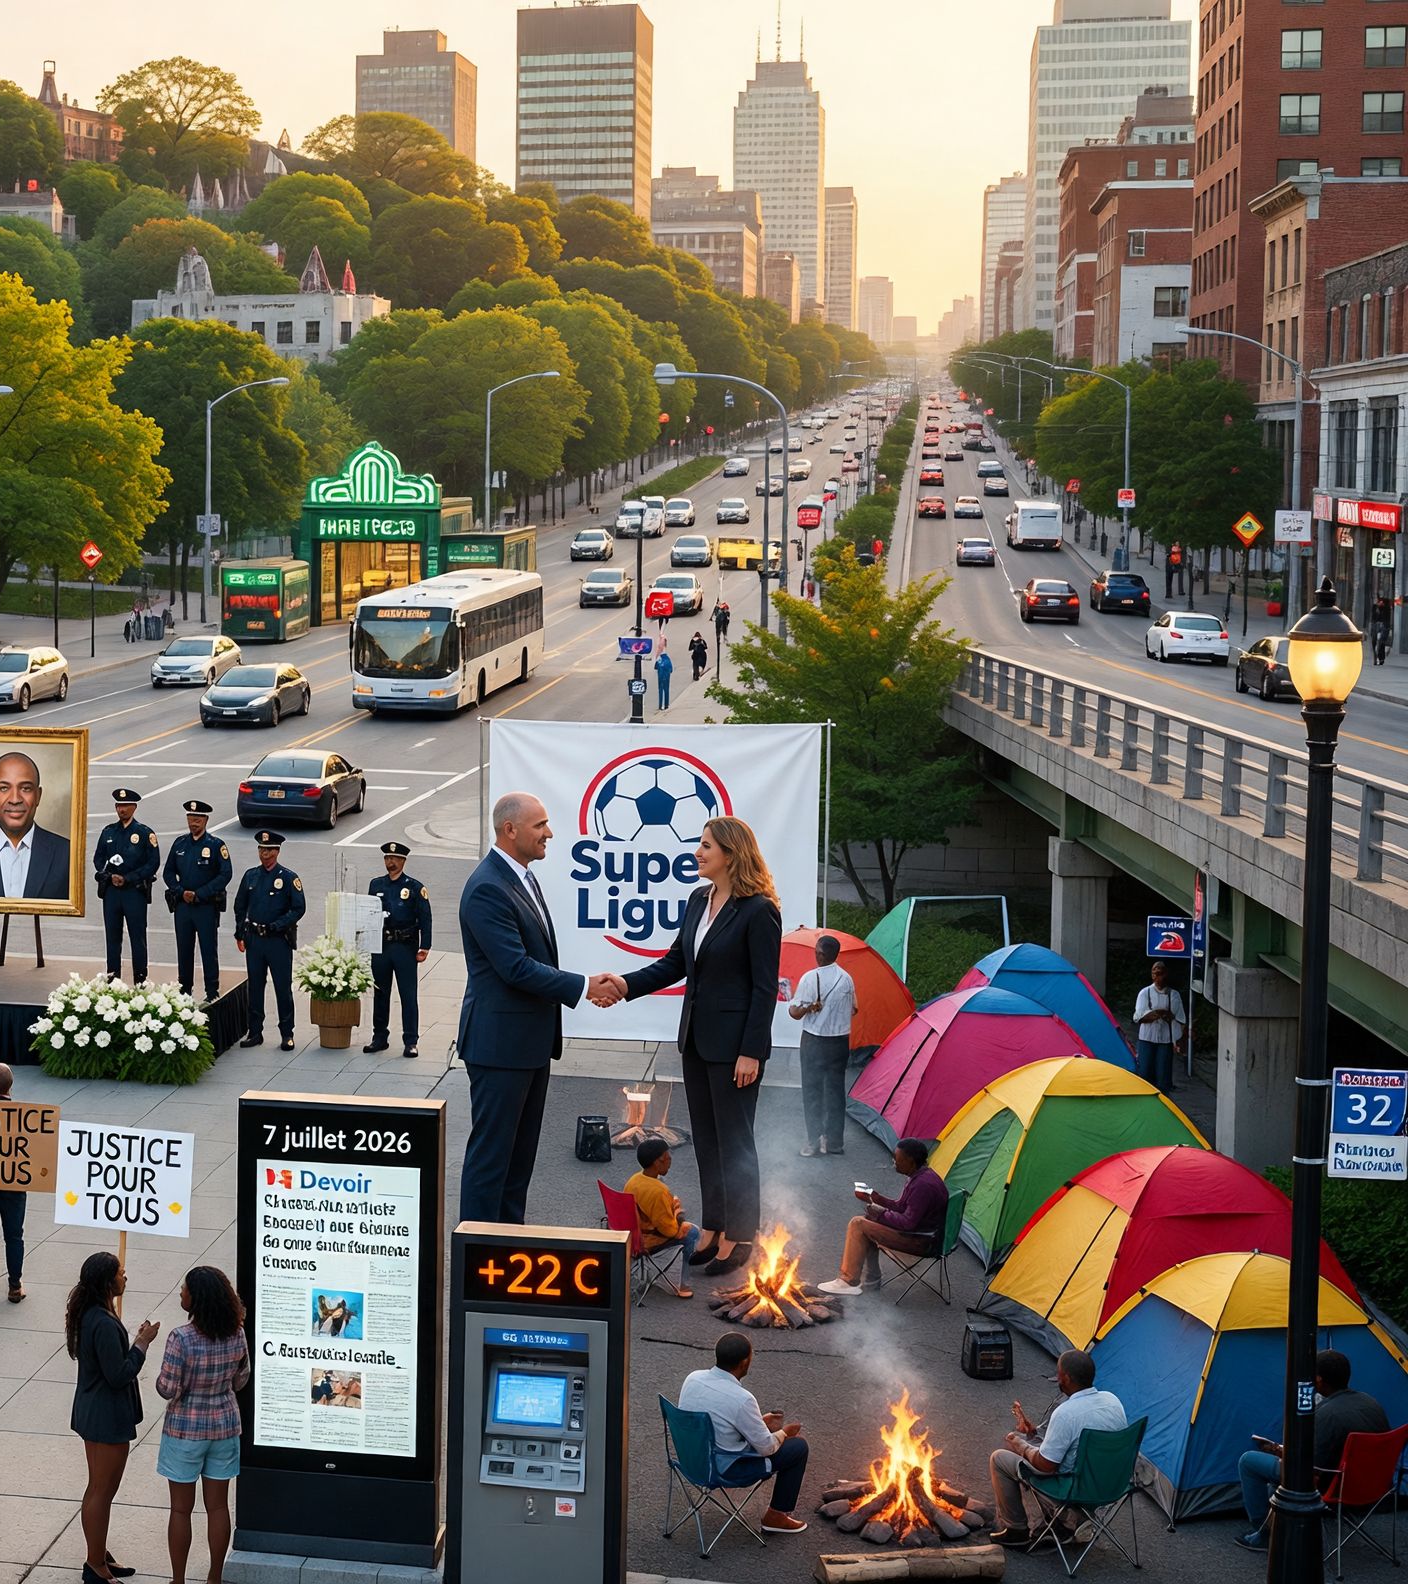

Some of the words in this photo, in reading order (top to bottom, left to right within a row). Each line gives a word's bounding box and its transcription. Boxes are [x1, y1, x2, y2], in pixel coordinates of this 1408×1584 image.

[570, 840, 700, 894] Supe
[578, 887, 687, 941] Ligu
[1347, 1094, 1392, 1126] 32
[66, 1129, 182, 1168] JUSTICE
[263, 1124, 276, 1145] 7
[282, 1125, 346, 1153] juillet
[353, 1129, 412, 1154] 2026
[87, 1161, 157, 1195] POUR
[300, 1170, 372, 1194] Devoir
[86, 1192, 160, 1226] TOUS
[478, 1253, 561, 1296] +22
[574, 1258, 599, 1295] C
